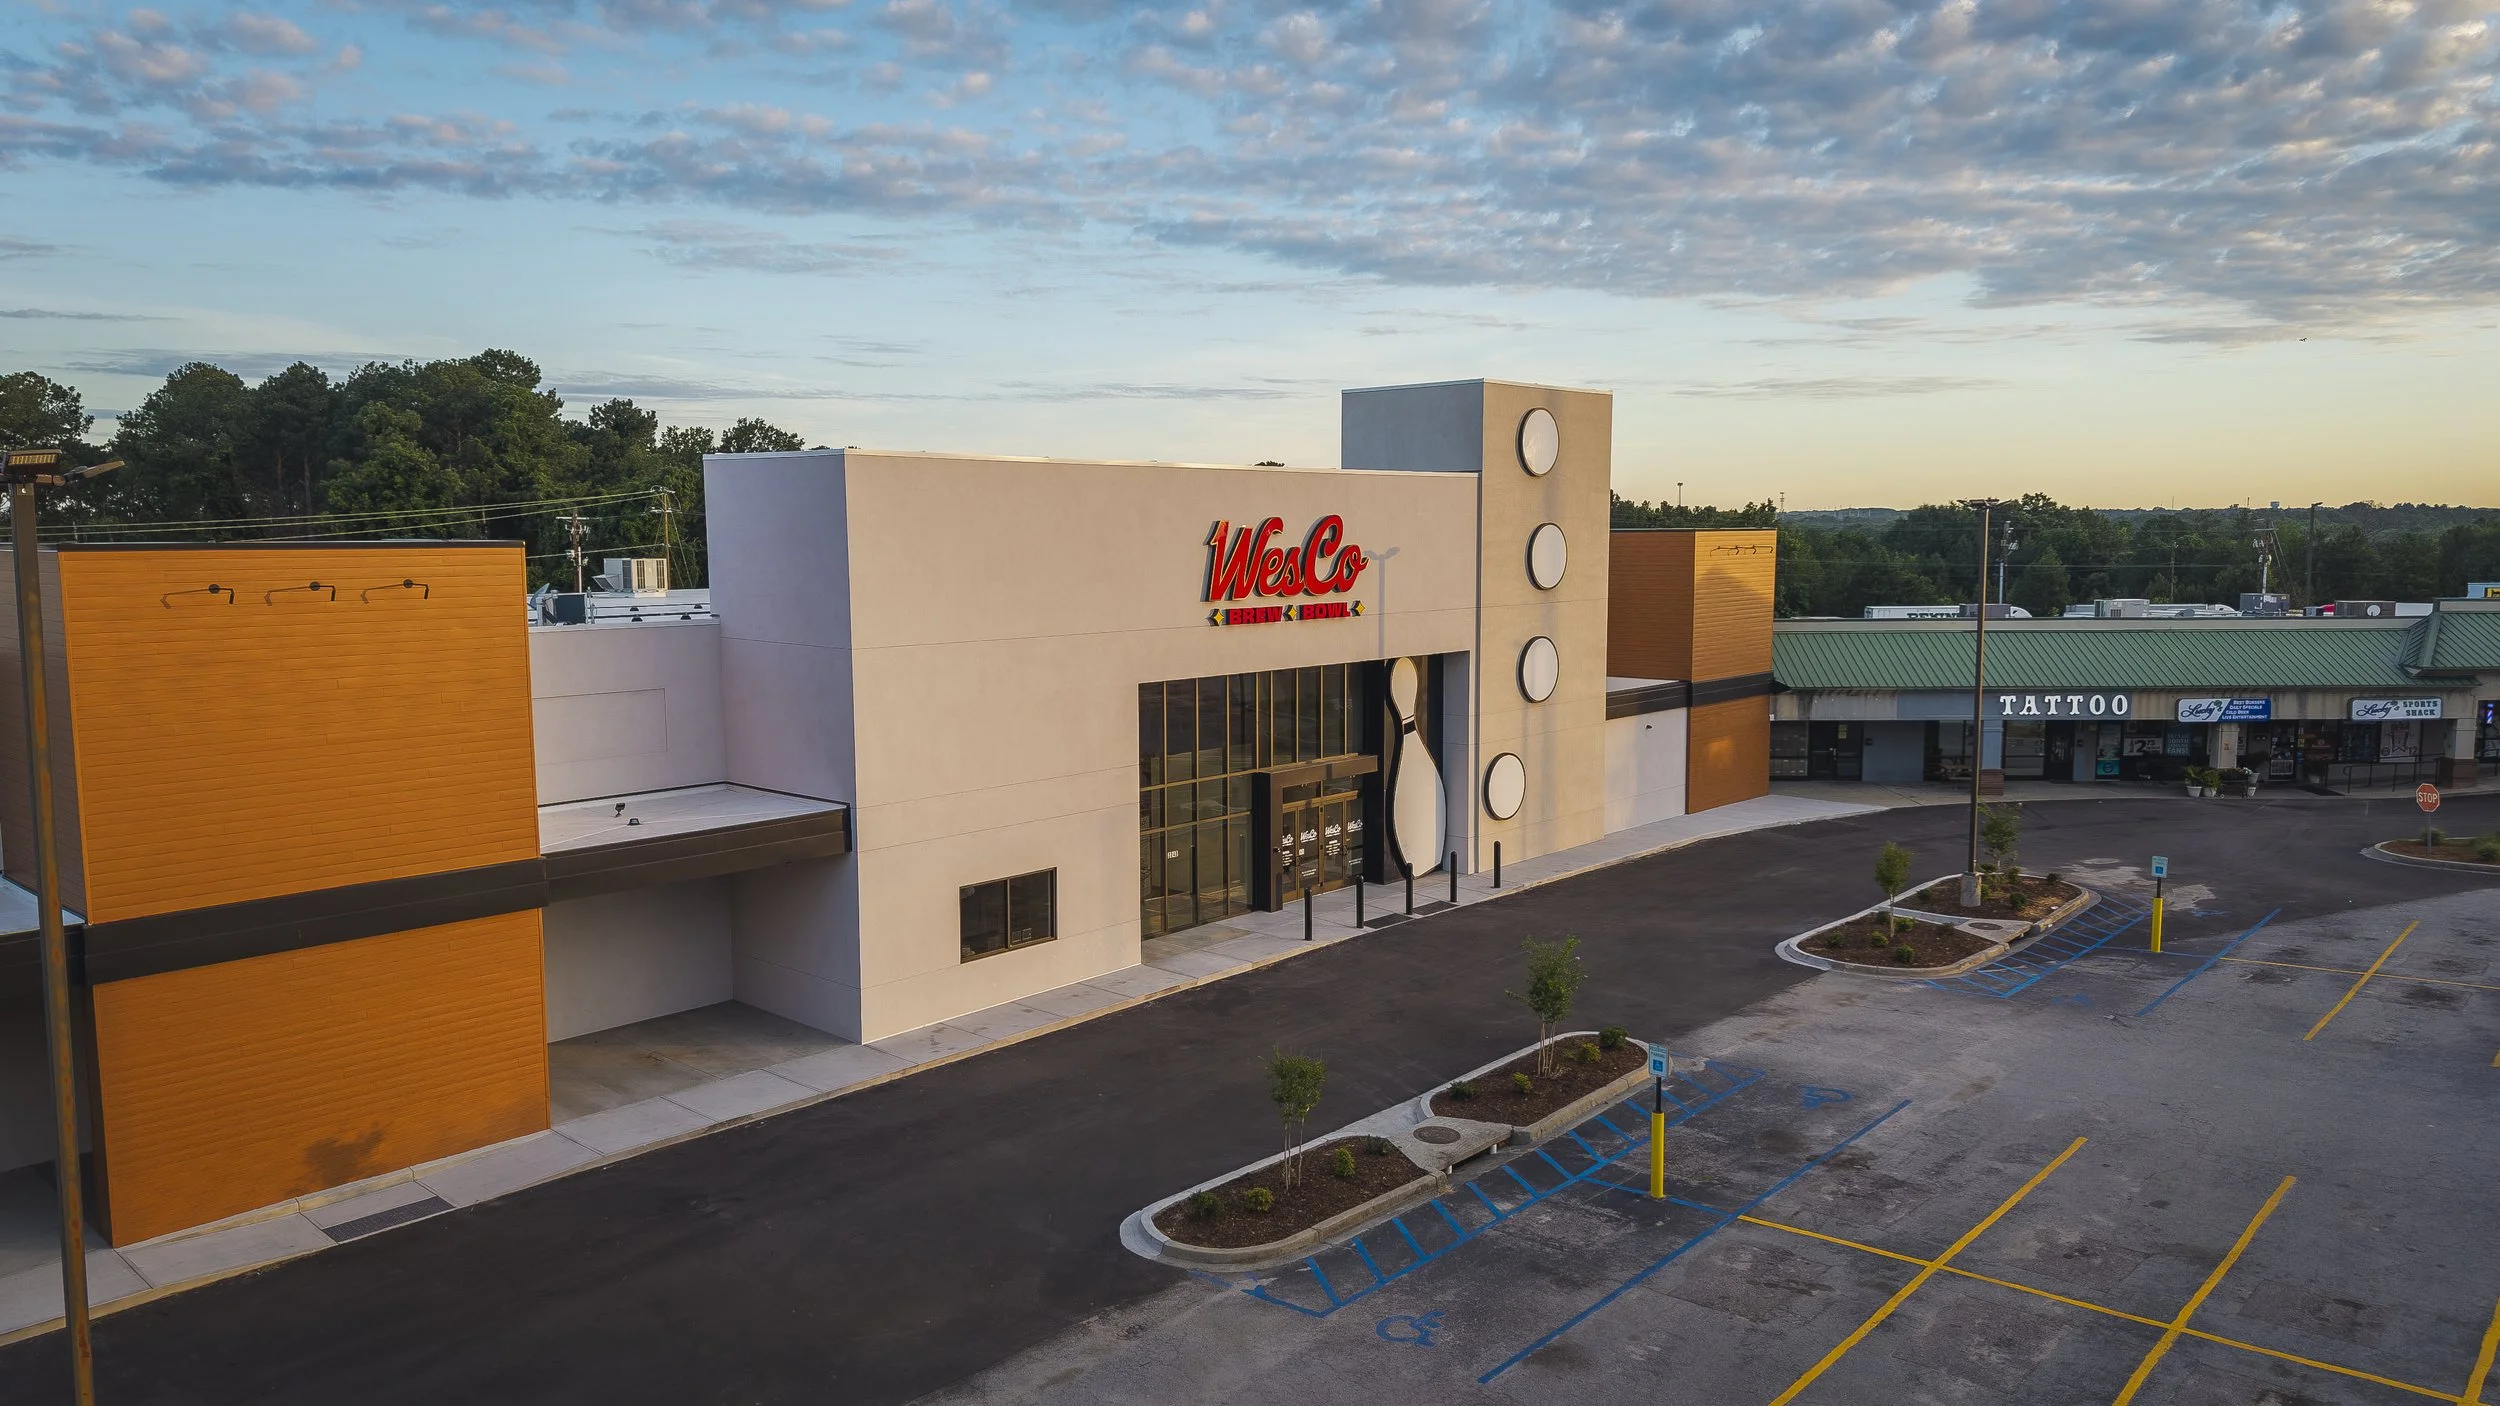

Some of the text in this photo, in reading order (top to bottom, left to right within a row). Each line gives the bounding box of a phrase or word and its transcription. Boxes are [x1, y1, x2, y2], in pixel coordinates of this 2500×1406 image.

[1201, 514, 1370, 601] WesCo
[1227, 602, 1351, 625] BREW BOWL
[1999, 694, 2128, 716] TATTOO
[2180, 700, 2224, 721] Lucky's
[2356, 701, 2400, 719] Lucky's
[2405, 709, 2436, 717] SHACK
[2418, 791, 2438, 804] STOP
